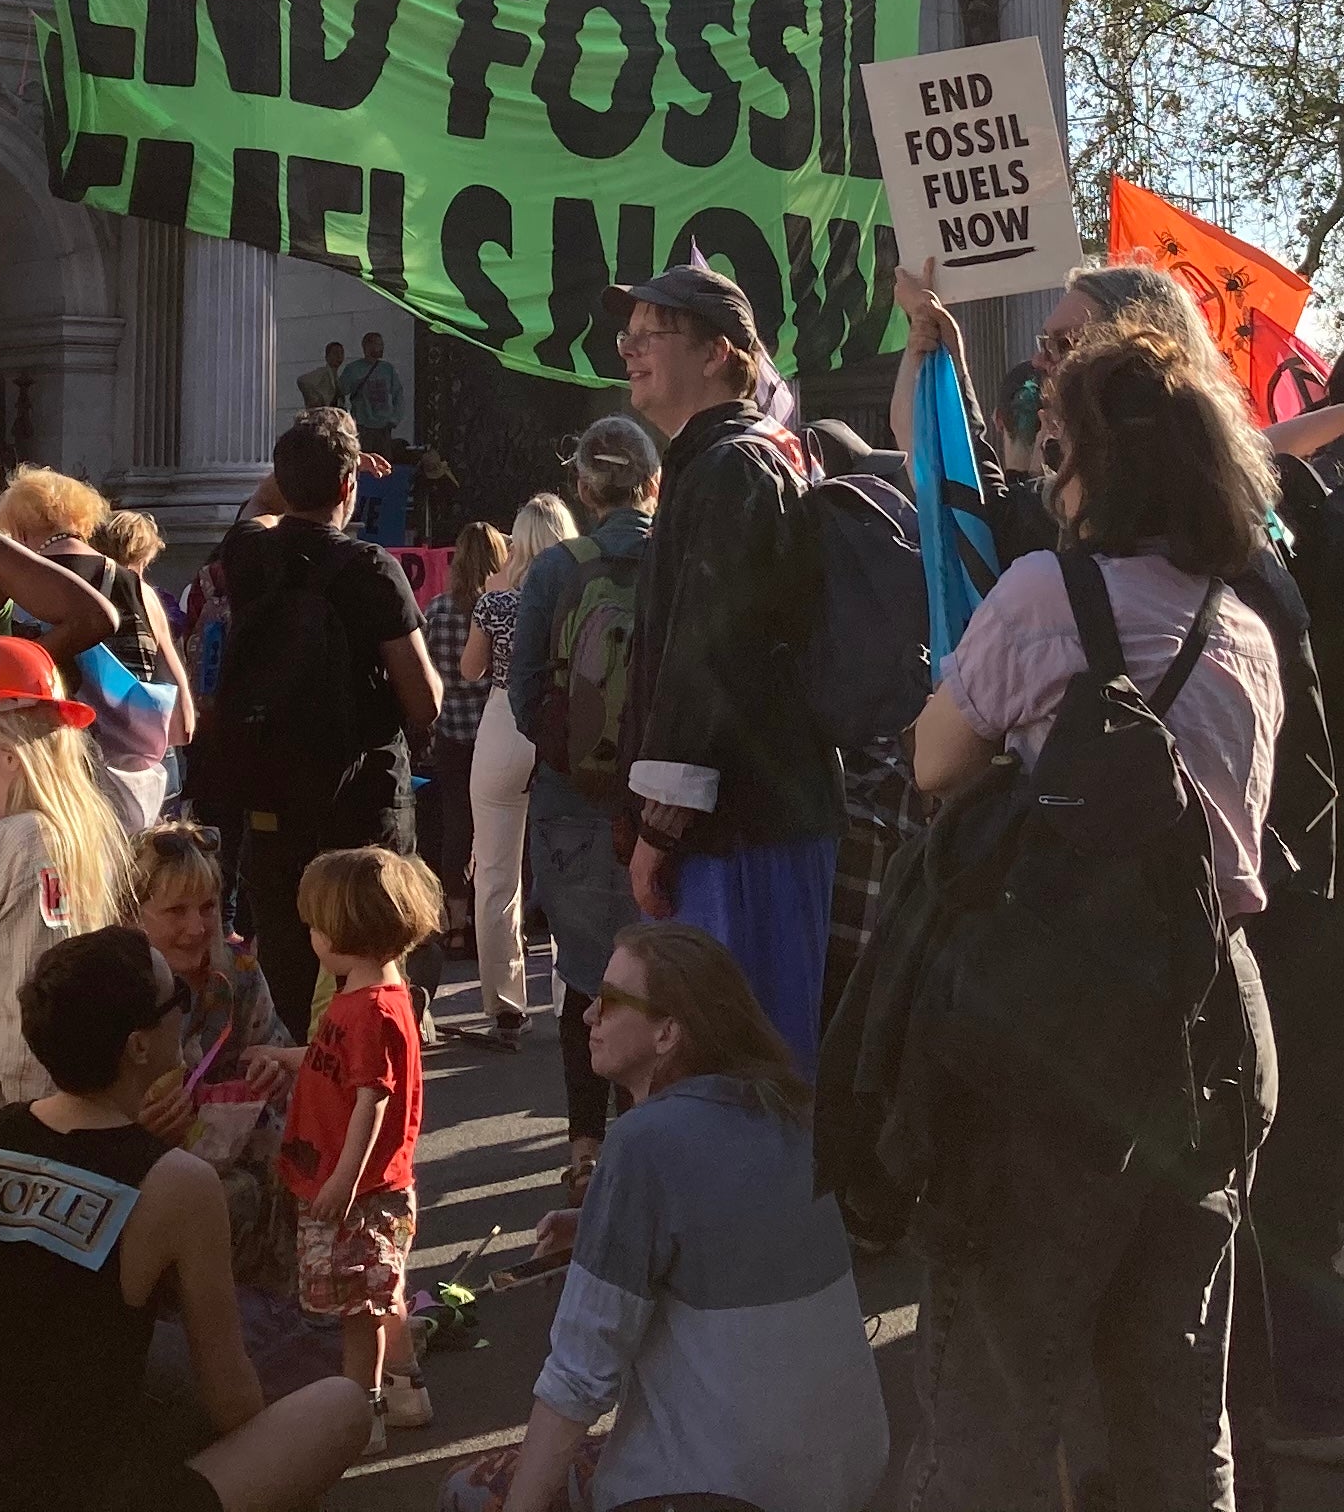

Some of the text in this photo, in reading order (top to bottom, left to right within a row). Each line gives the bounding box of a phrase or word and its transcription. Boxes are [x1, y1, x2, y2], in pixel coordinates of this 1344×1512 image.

[919, 73, 993, 116] END
[905, 113, 1030, 165] FOSSIL
[922, 159, 1030, 209] FUELS
[938, 205, 1030, 252] NOW
